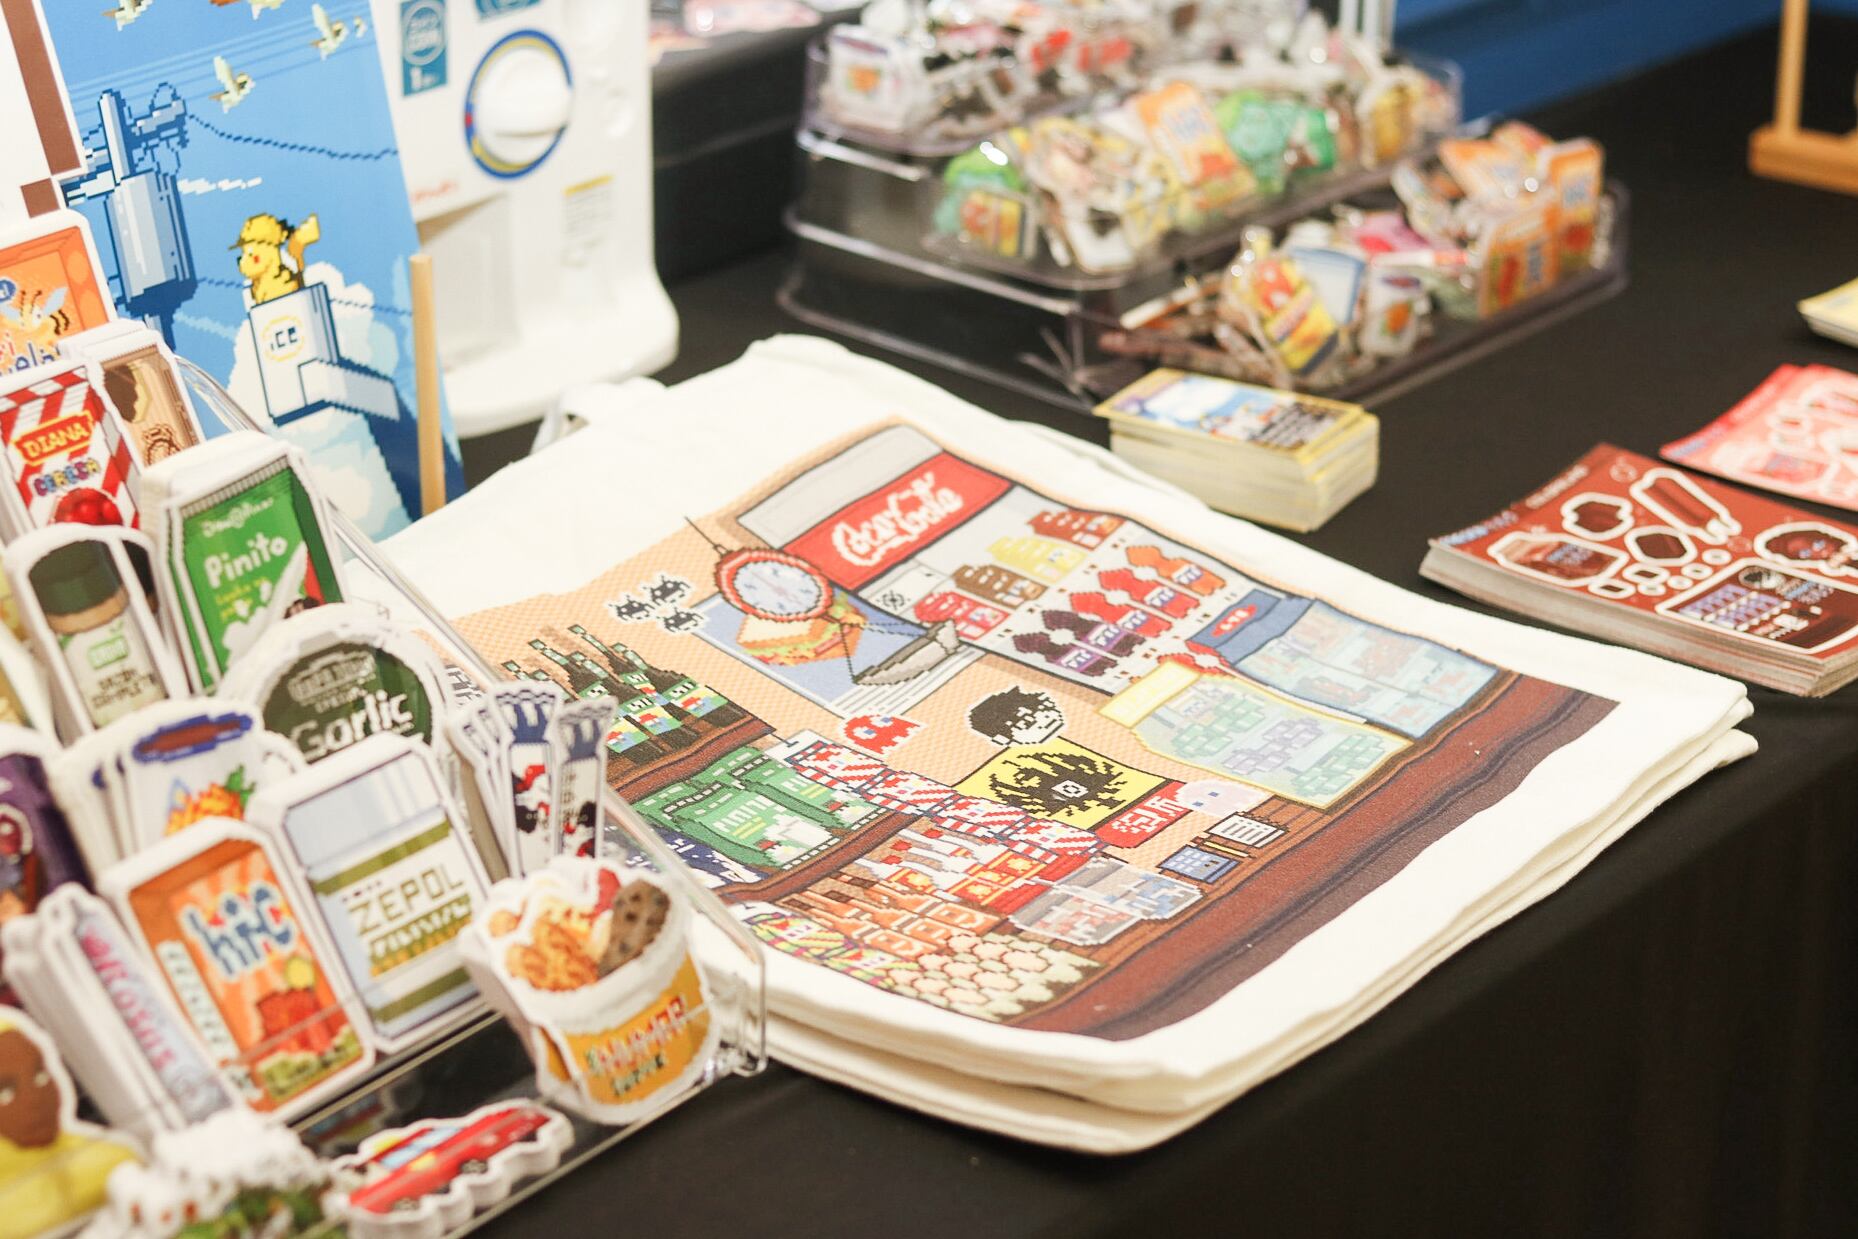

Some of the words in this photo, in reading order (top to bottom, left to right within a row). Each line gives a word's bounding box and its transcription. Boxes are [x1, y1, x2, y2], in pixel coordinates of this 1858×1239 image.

[22, 421, 92, 459] DIANA
[204, 532, 288, 589] Pinito
[290, 689, 414, 761] Garlic
[348, 864, 465, 936] ZEPOL
